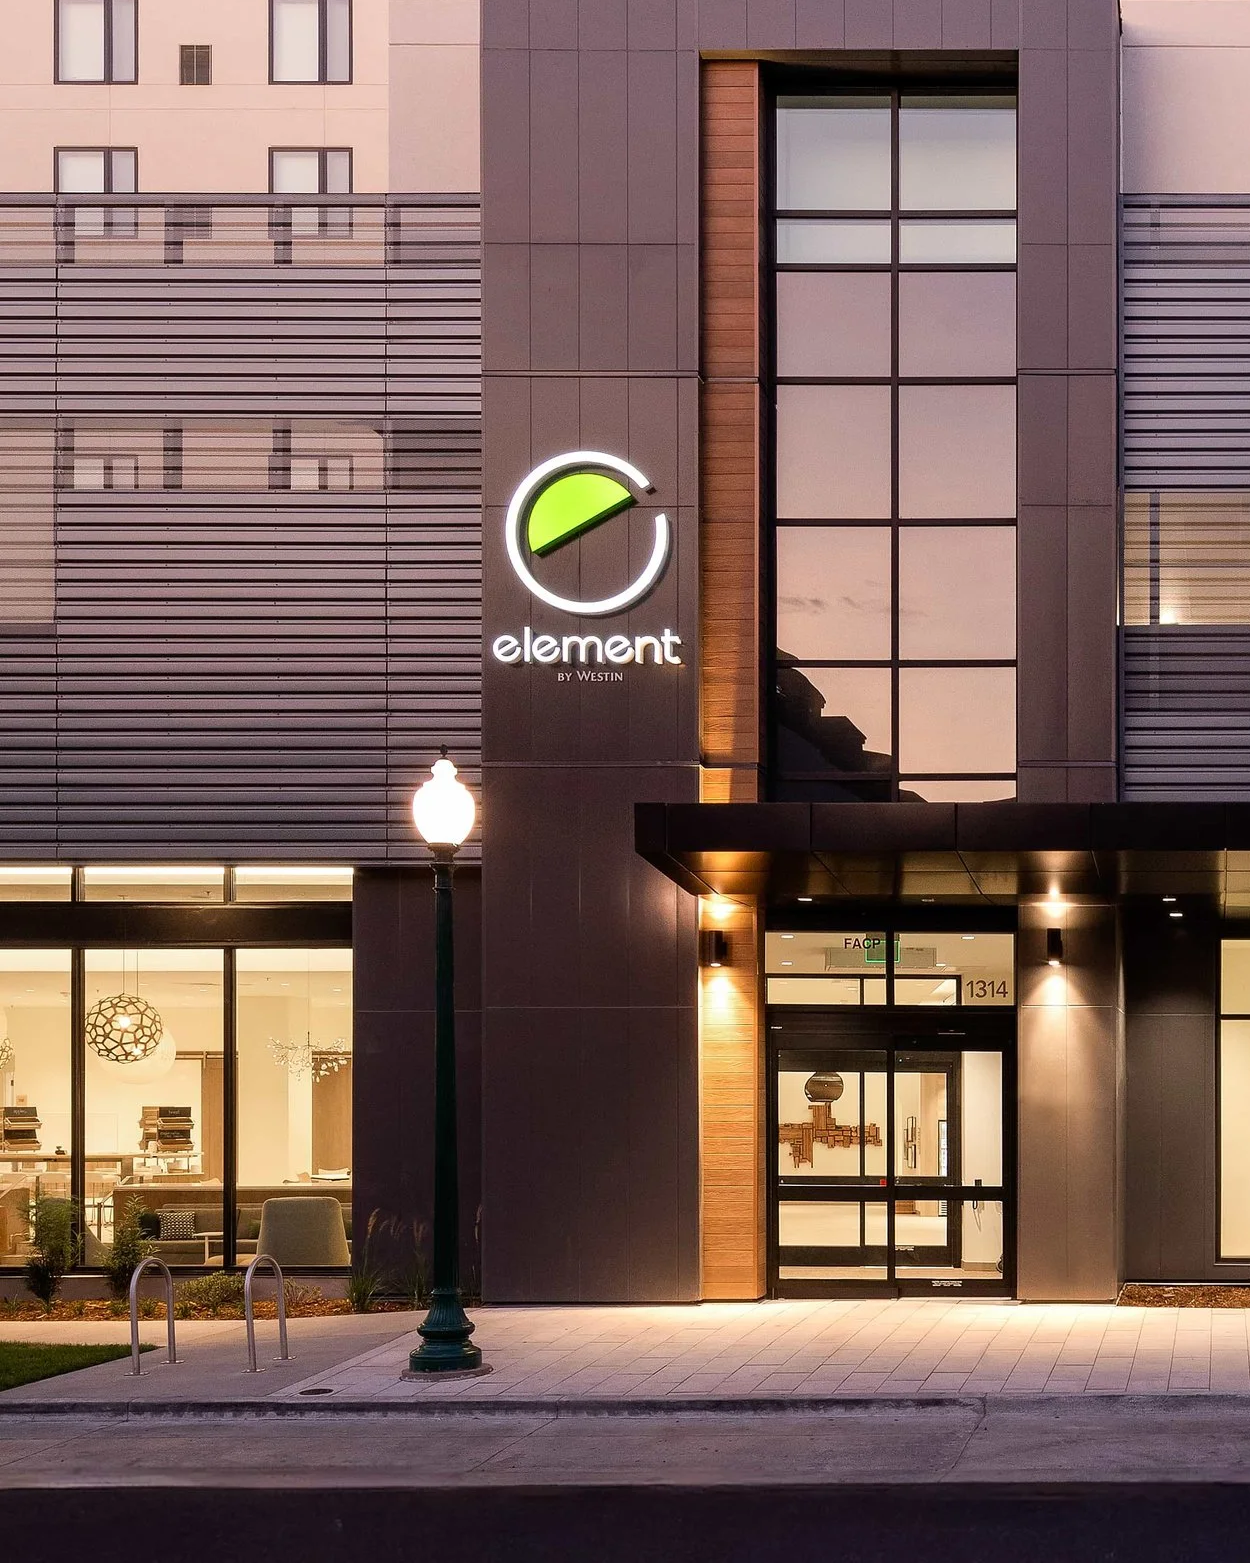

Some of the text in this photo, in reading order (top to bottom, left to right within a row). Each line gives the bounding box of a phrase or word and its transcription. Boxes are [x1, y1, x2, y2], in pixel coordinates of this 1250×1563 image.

[492, 626, 683, 665] element
[557, 672, 574, 682] BY
[843, 937, 882, 950] FACP
[965, 979, 1009, 999] 1314
